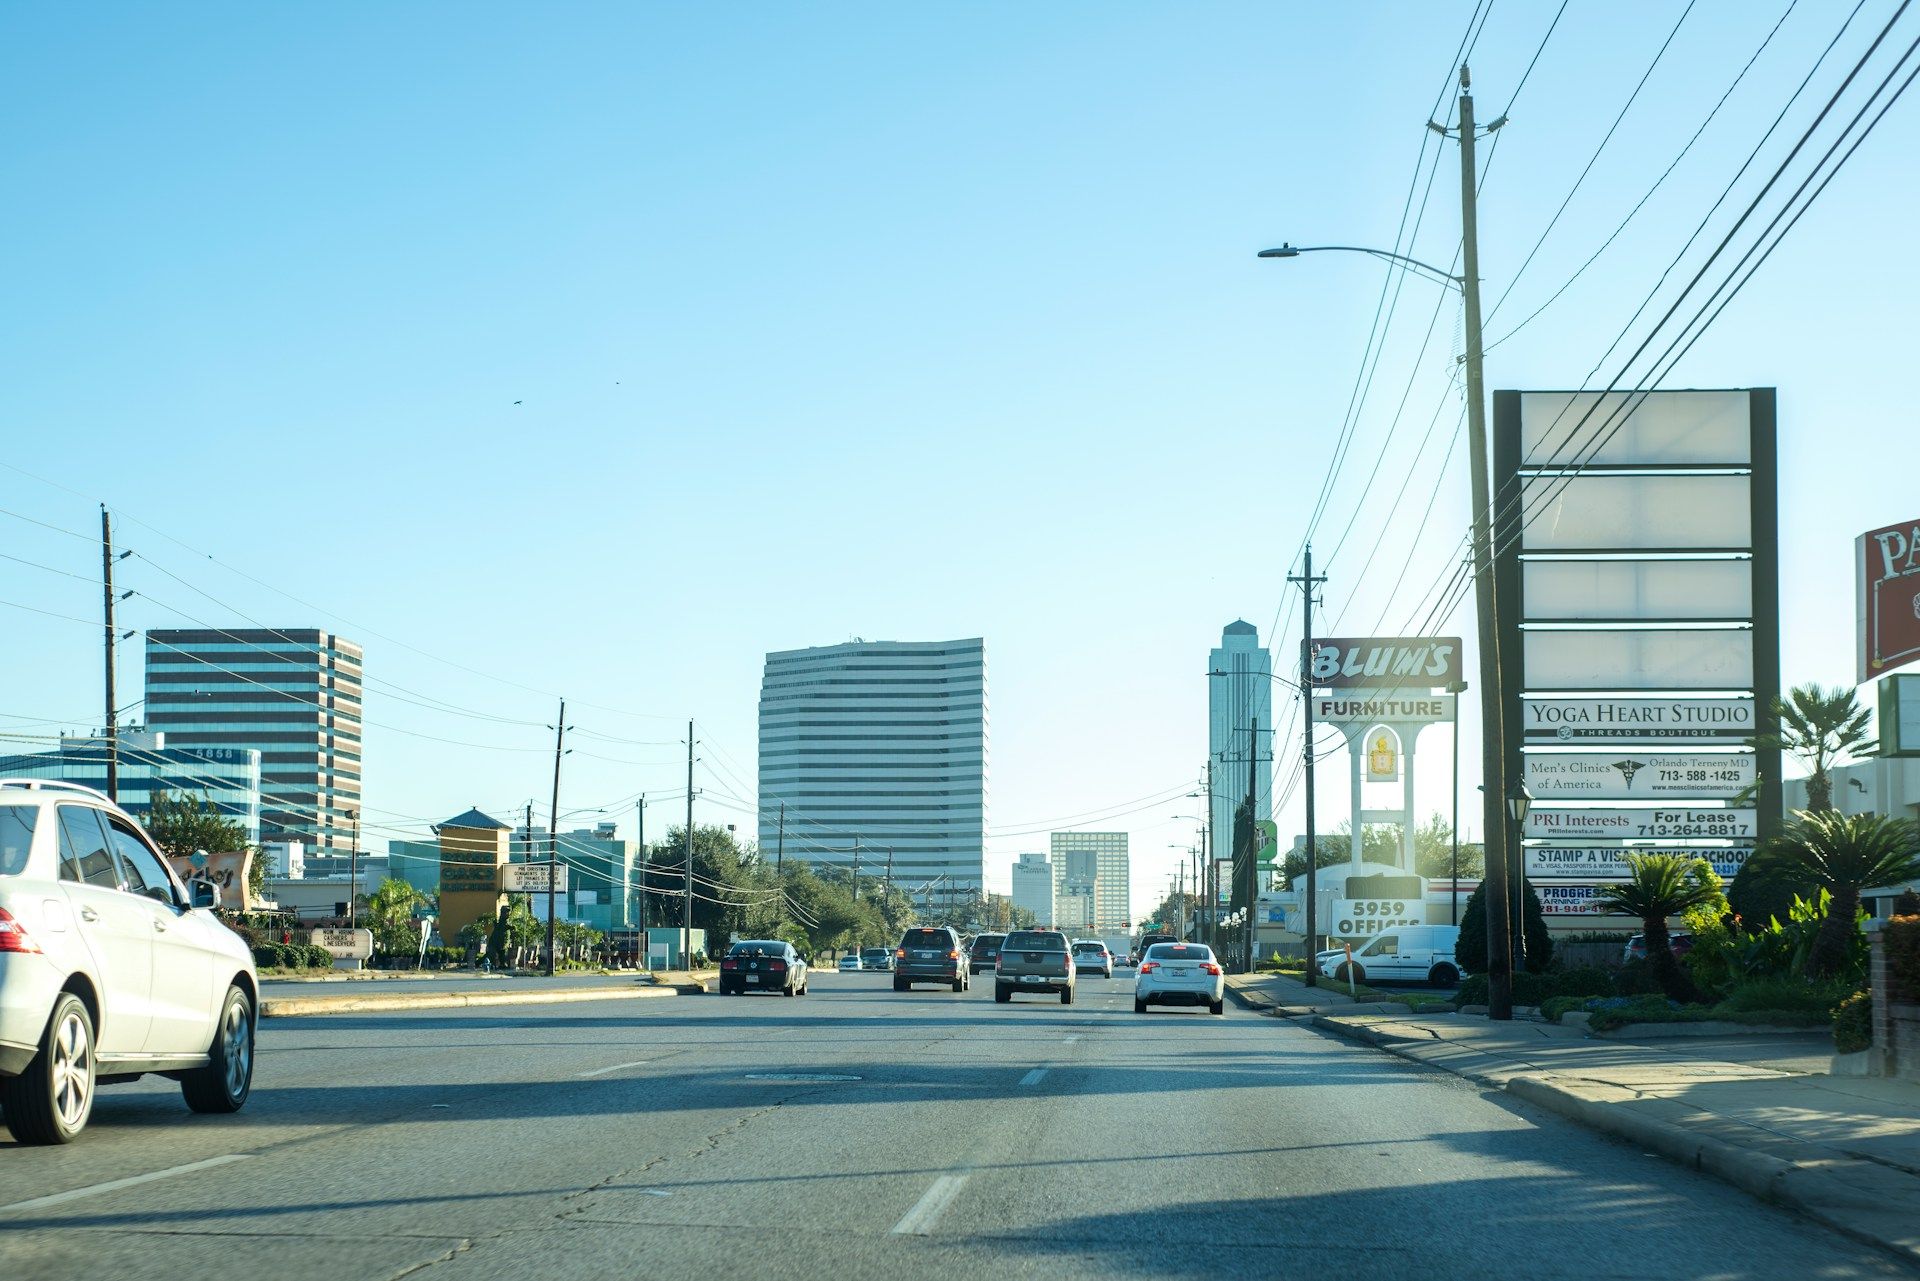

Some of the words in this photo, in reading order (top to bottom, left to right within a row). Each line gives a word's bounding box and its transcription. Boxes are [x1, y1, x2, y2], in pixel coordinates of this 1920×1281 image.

[1312, 643, 1454, 678] BLUM'S
[1321, 701, 1443, 716] FURNITURE
[1531, 704, 1590, 723] YOGA
[1596, 704, 1666, 723] HEART
[1671, 703, 1749, 723] STUDIO
[1531, 762, 1566, 773] Men's
[1569, 762, 1611, 773] Clinics
[1649, 758, 1687, 768] Orlando
[1730, 759, 1749, 768] MD
[1686, 770, 1706, 781] 588
[1537, 778, 1550, 789] of
[1553, 778, 1602, 789] America
[1533, 814, 1560, 826] PRI
[1566, 814, 1630, 826] Interests
[1654, 811, 1681, 823] For
[1686, 811, 1736, 823] Lease
[1637, 824, 1749, 836] 713-264-8817
[1538, 849, 1583, 862] STAMP
[1587, 849, 1597, 862] A
[1353, 901, 1405, 916] 5959
